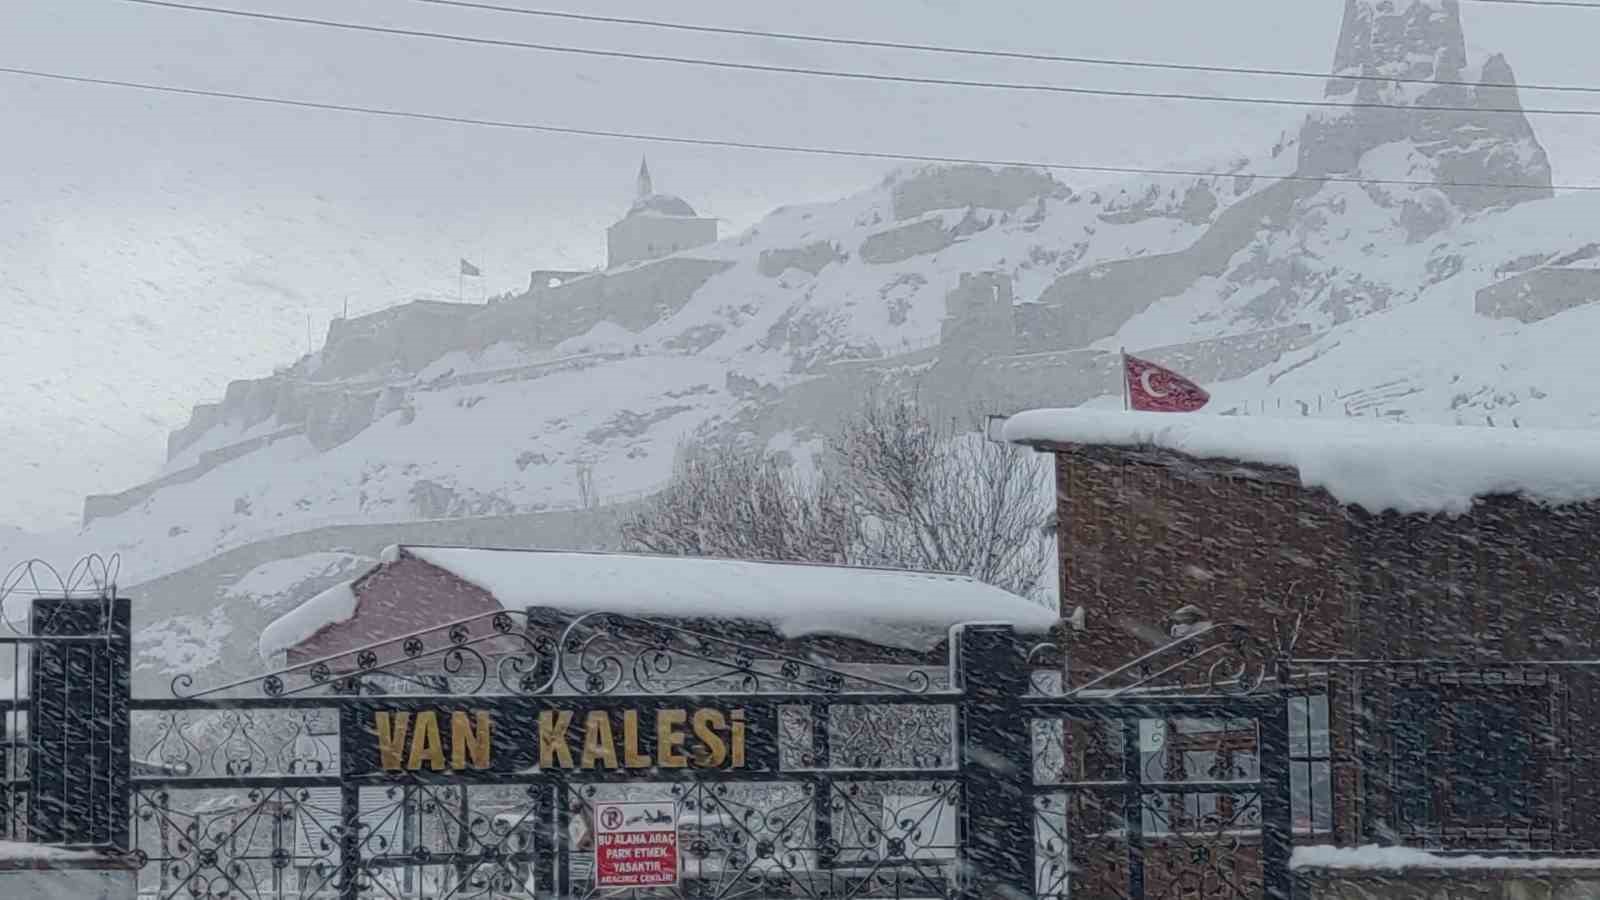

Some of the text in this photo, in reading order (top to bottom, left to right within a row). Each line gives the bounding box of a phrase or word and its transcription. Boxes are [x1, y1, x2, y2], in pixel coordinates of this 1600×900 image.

[375, 710, 493, 770] VAN
[598, 833, 675, 846] BU ALANA ARAÇ
[606, 847, 668, 859] PARK ETMEK
[614, 862, 661, 872] YASAKTIR
